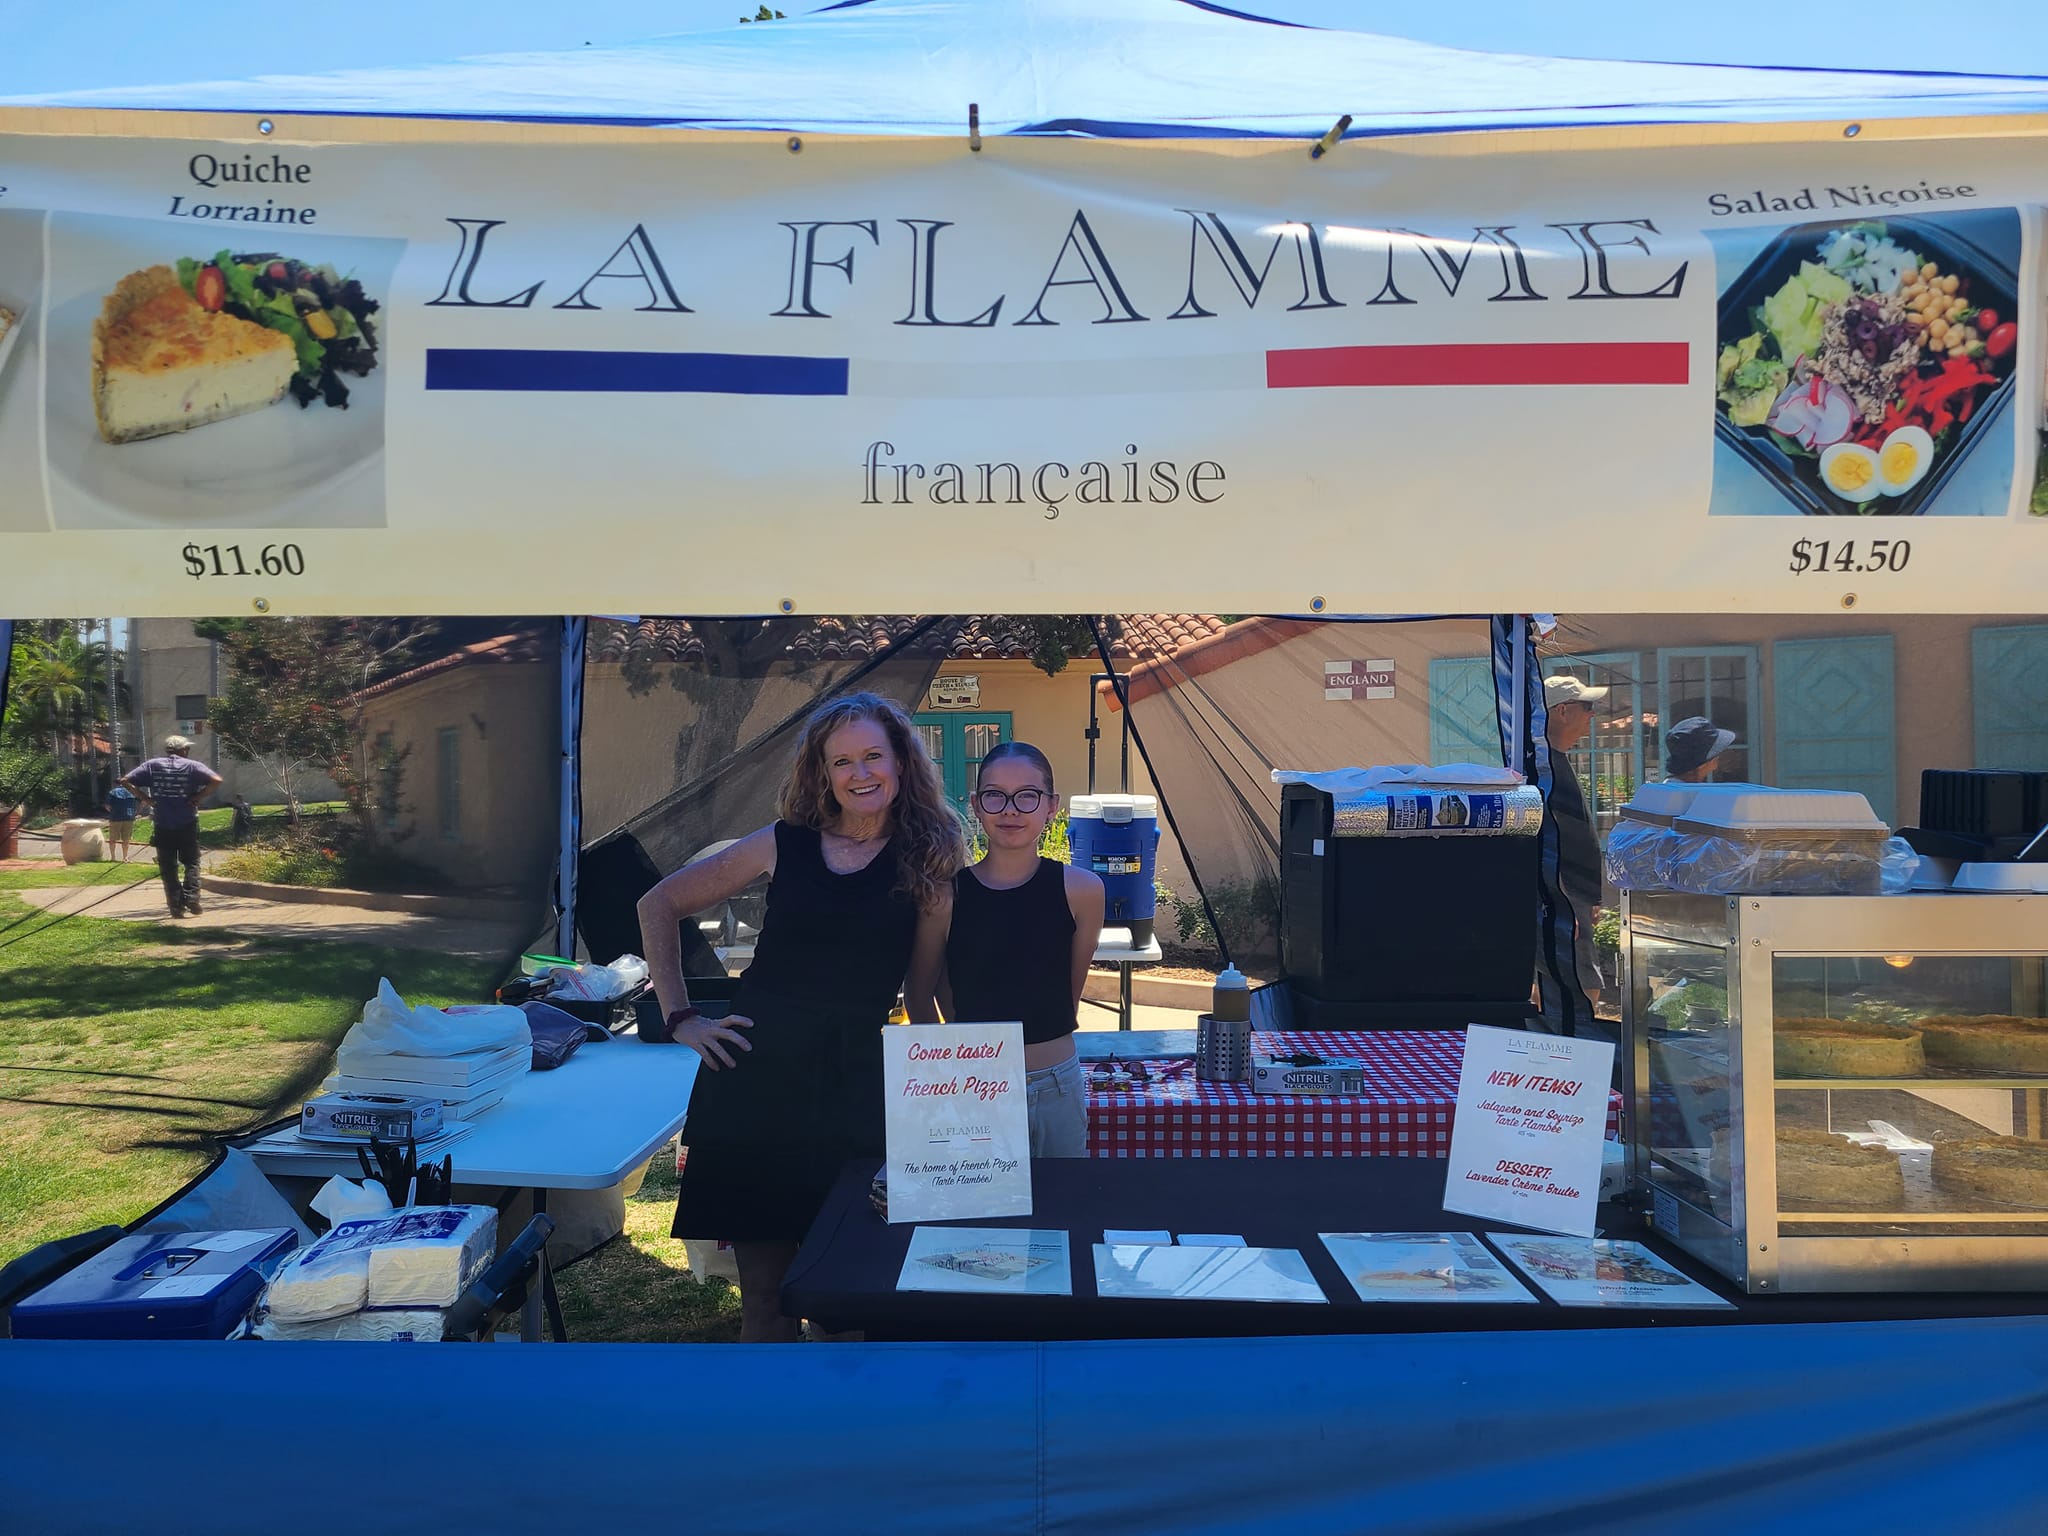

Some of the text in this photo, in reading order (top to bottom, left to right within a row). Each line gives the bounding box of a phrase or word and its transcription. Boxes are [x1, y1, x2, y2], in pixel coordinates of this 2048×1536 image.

[188, 153, 312, 188] Quiche
[1708, 181, 1977, 216] Salad Niçoise
[168, 196, 317, 225] Lorraine
[424, 208, 1689, 327] LA FLAMME
[860, 440, 1227, 520] française
[182, 541, 305, 580] $11.60
[1789, 536, 1911, 576] $14.50
[1330, 674, 1389, 686] ENGLAND
[907, 1040, 1004, 1060] Come taste!
[1508, 1039, 1572, 1054] LA FLAMME
[902, 1076, 1010, 1101] French Pizza
[1286, 1074, 1329, 1083] NITRILE
[1486, 1070, 1583, 1096] NEW ITEMS!
[335, 1113, 377, 1125] NITRILE
[1477, 1099, 1584, 1127] Jalapeño and Soyrizo
[1496, 1114, 1519, 1127] Tarte
[929, 1125, 991, 1137] LA FLAMME
[904, 1158, 1019, 1175] The home of French Pizza
[1465, 1169, 1509, 1186] Lavender
[931, 1176, 955, 1187] (Tarte
